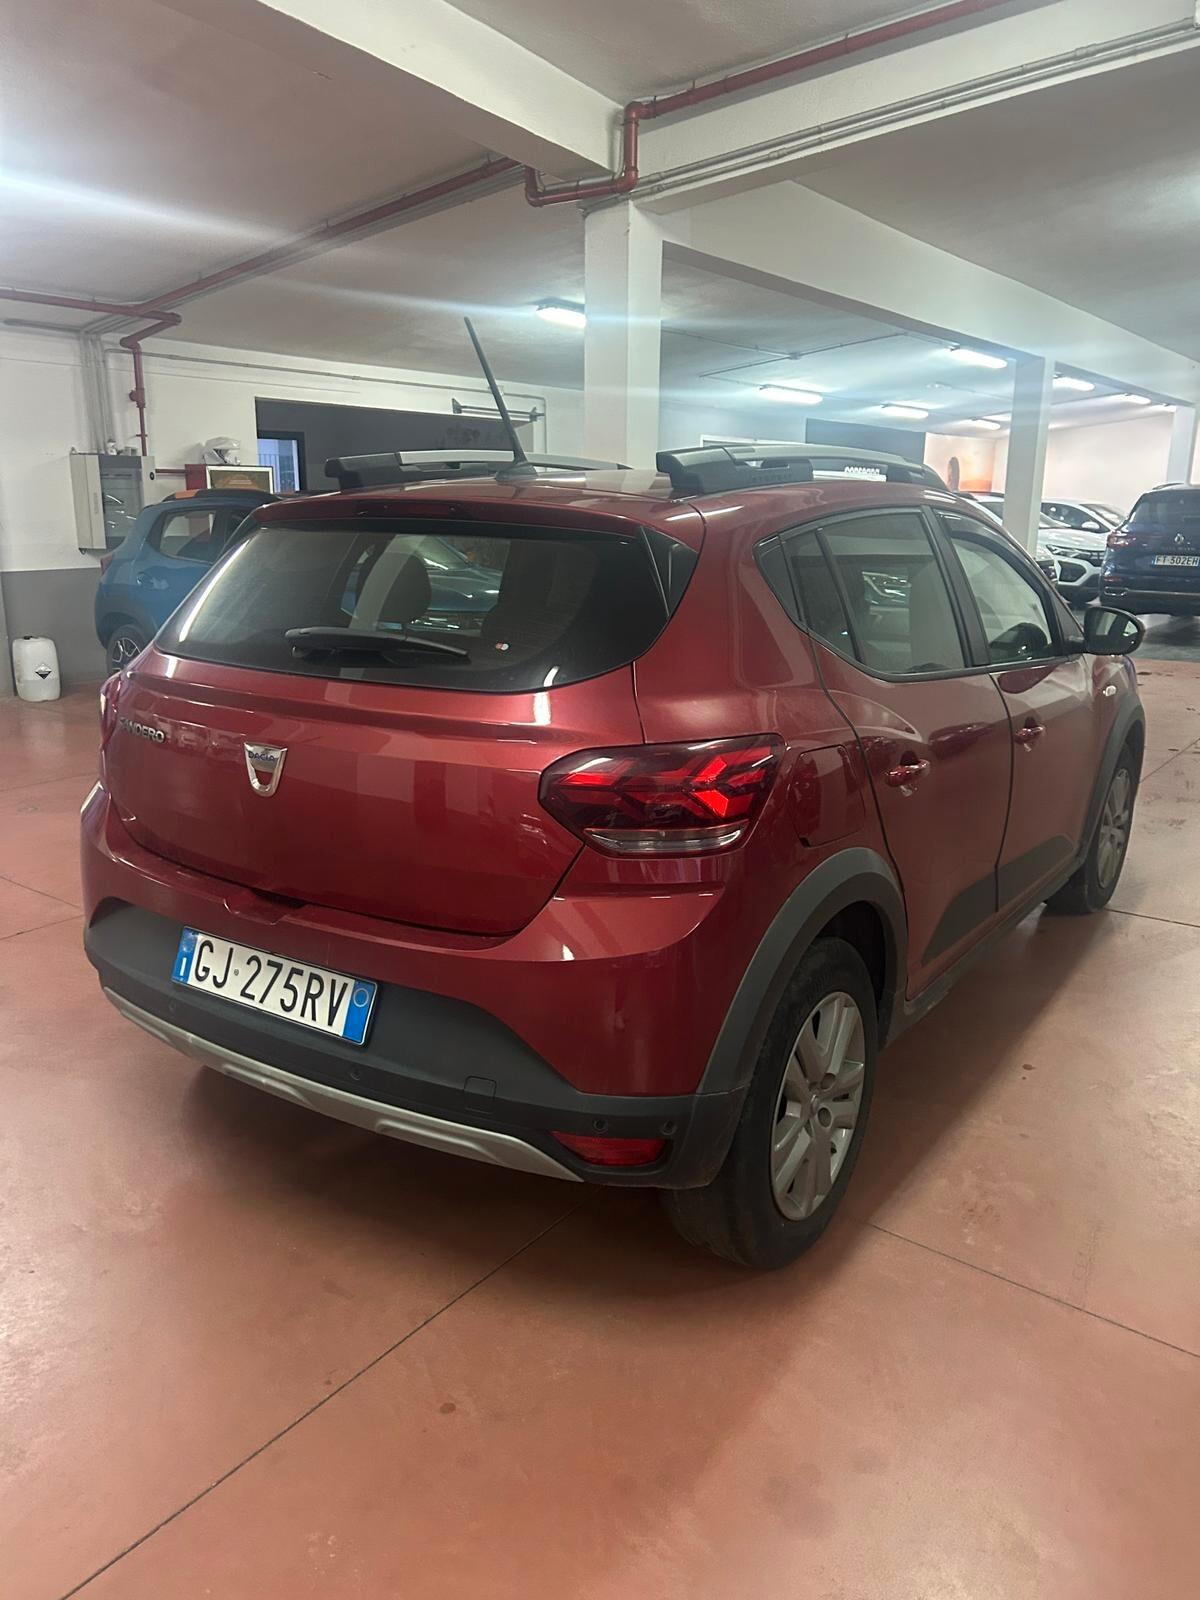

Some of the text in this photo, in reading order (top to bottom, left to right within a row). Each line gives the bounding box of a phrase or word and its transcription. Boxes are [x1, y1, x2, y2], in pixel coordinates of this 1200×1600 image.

[248, 750, 276, 762] DACIA
[194, 939, 349, 1027] GJ 275RV
